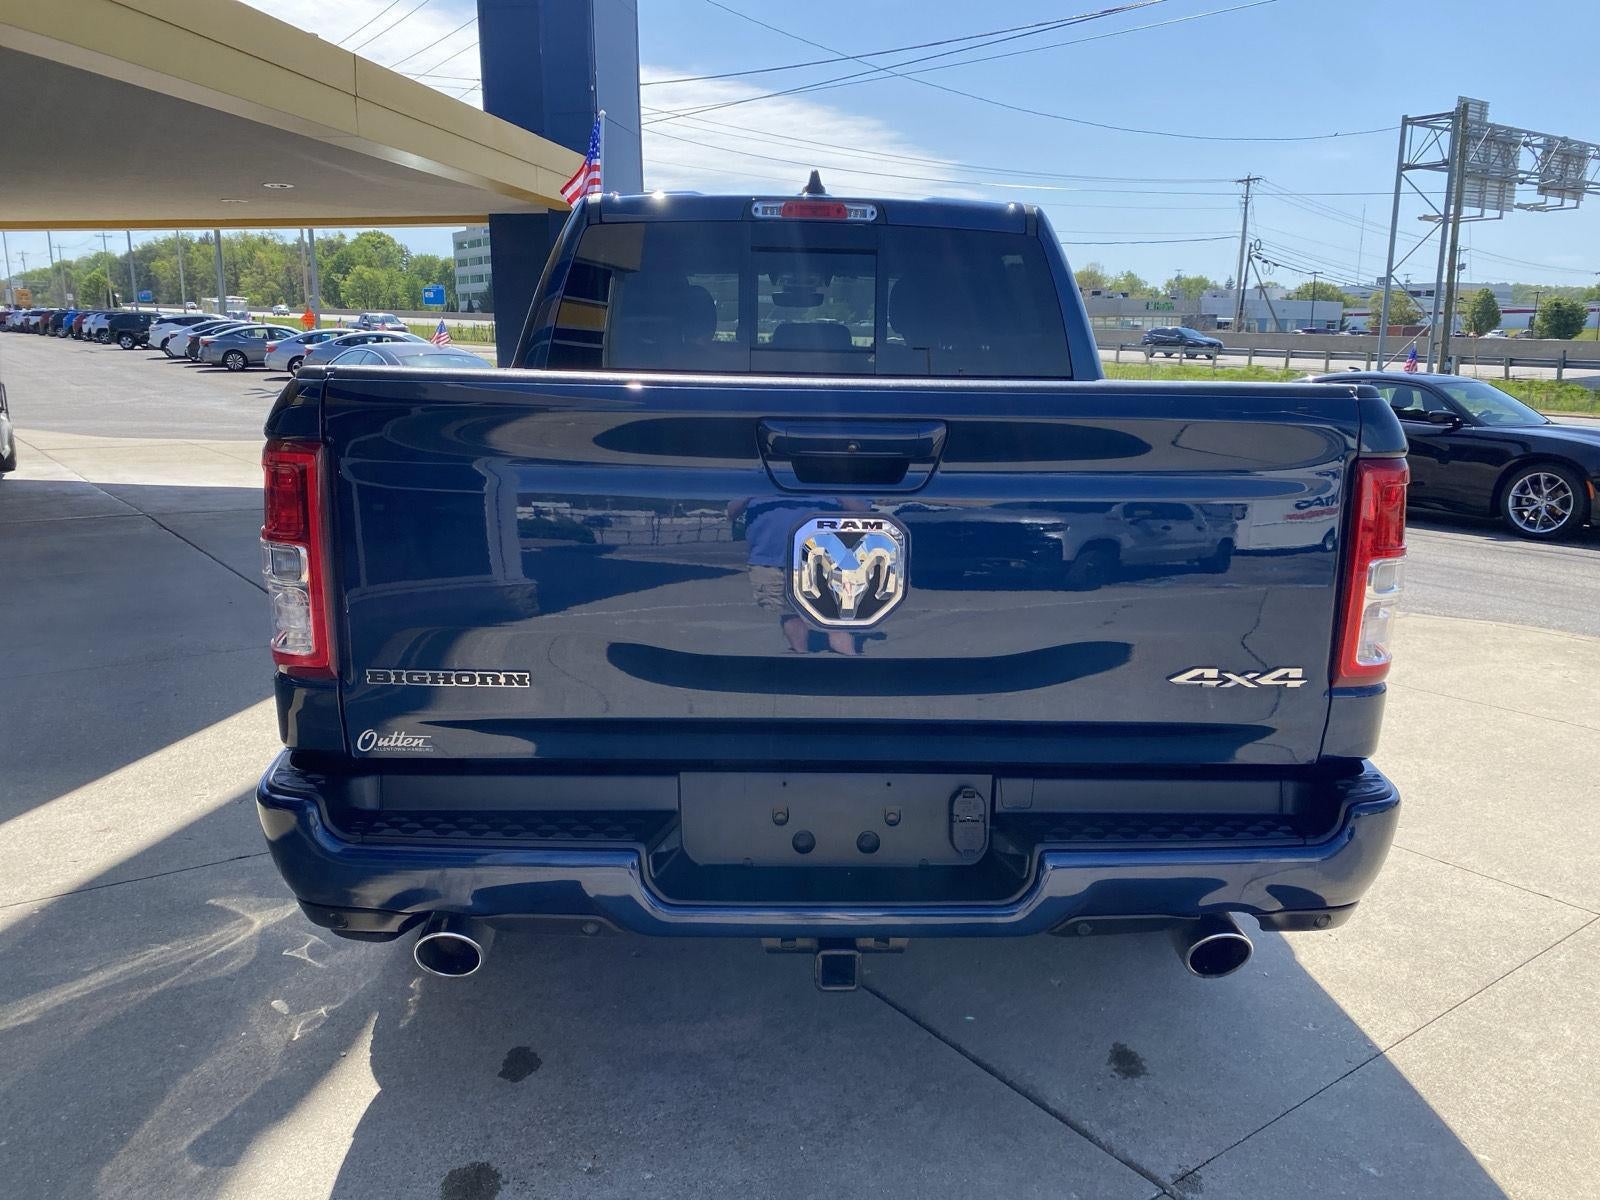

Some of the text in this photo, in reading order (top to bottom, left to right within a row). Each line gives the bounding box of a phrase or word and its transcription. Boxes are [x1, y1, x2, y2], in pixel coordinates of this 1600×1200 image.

[816, 520, 883, 530] RAM
[366, 669, 531, 688] BIGHORN
[357, 729, 432, 752] Outten
